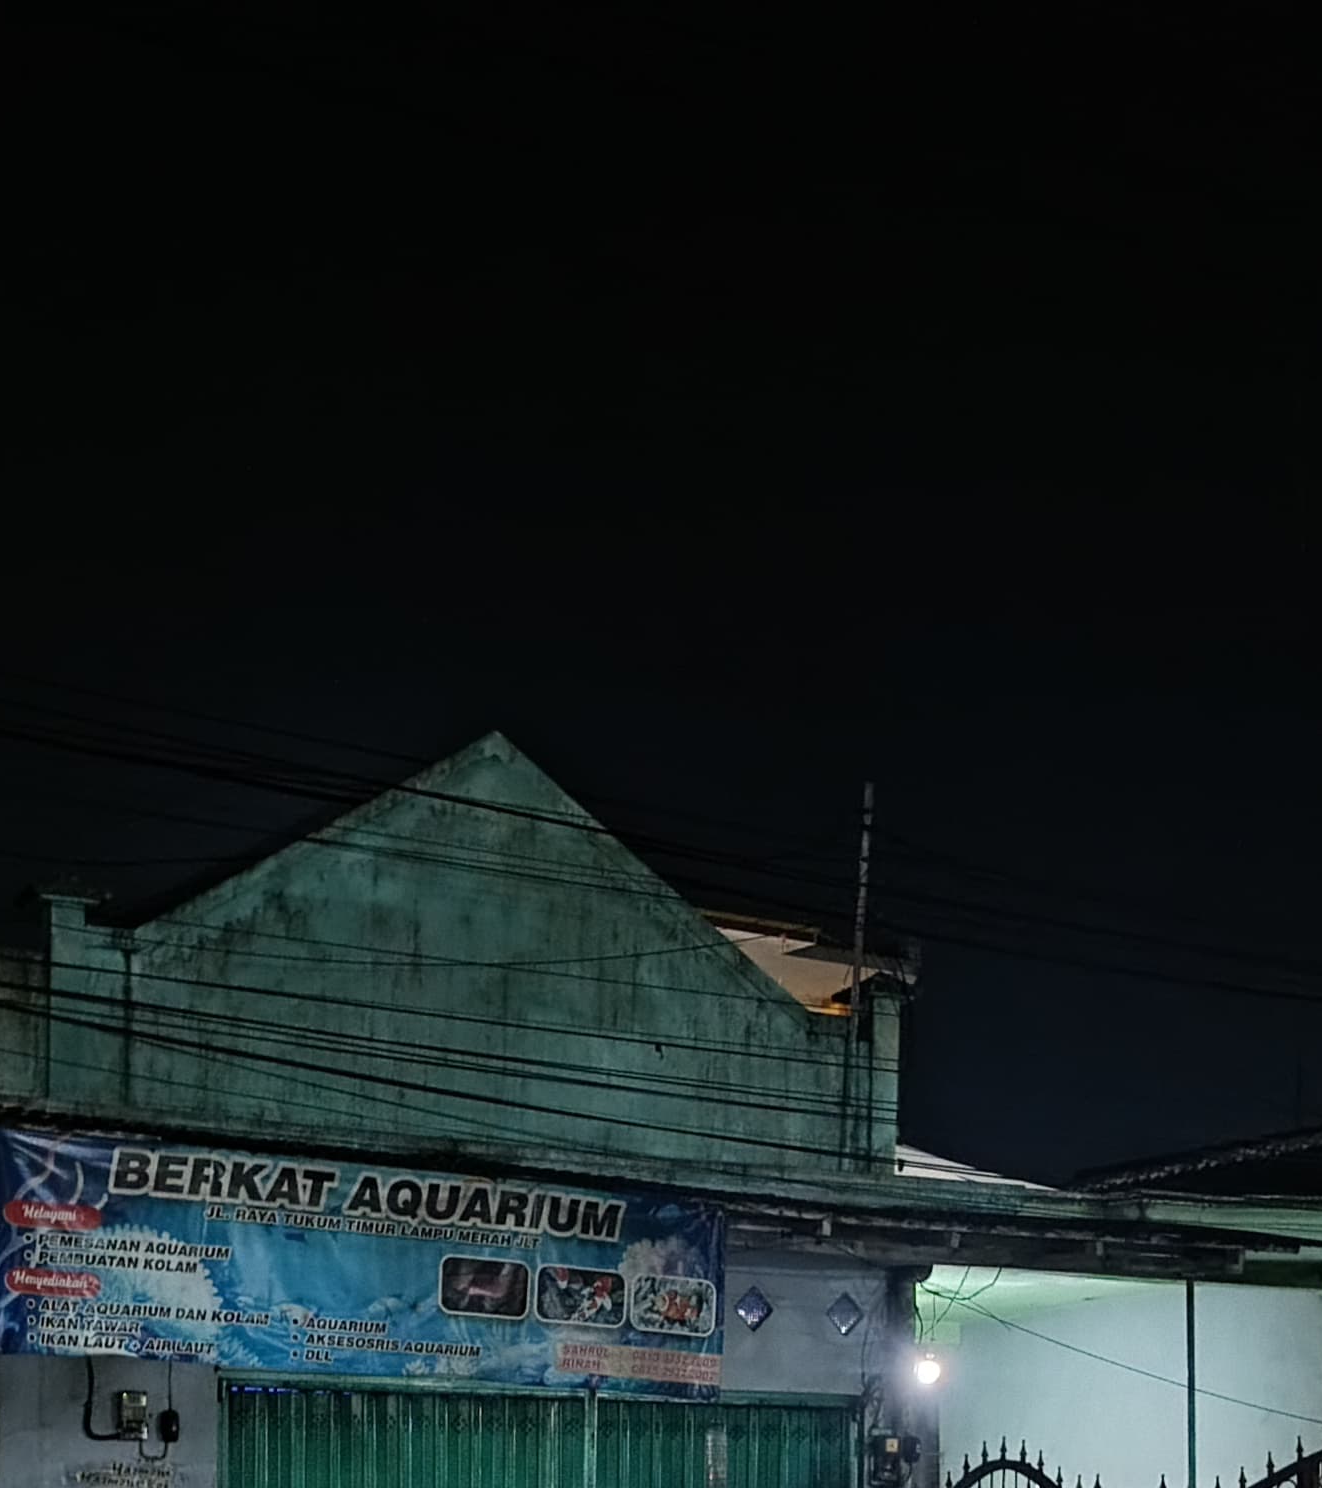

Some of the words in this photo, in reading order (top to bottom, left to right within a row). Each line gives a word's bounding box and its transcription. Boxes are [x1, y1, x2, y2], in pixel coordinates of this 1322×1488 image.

[111, 1149, 337, 1208] BERKAT
[346, 1174, 623, 1240] AQUARIUM
[206, 1206, 231, 1220] JL.
[235, 1208, 278, 1224] RAYA
[283, 1213, 342, 1230] TUKUM
[346, 1219, 396, 1236] TIMUR
[400, 1223, 454, 1241] LAMPU
[457, 1228, 512, 1246] MERAH
[38, 1234, 141, 1252] PEMESANAN
[145, 1241, 230, 1259] AQUARIUM
[38, 1251, 139, 1269] PEMBUATAN
[143, 1258, 197, 1273] KOLAM
[40, 1300, 79, 1314] ALAT
[85, 1302, 171, 1319] AQUARIUM
[176, 1308, 208, 1322] DAN
[211, 1311, 270, 1325] KOLAM
[40, 1317, 78, 1330] IKAN
[305, 1317, 387, 1333] AQUARIUM
[40, 1334, 79, 1347] IKAN
[83, 1336, 126, 1350] LAUT
[403, 1340, 481, 1357] AQUARIUM
[304, 1349, 333, 1362] DLL
